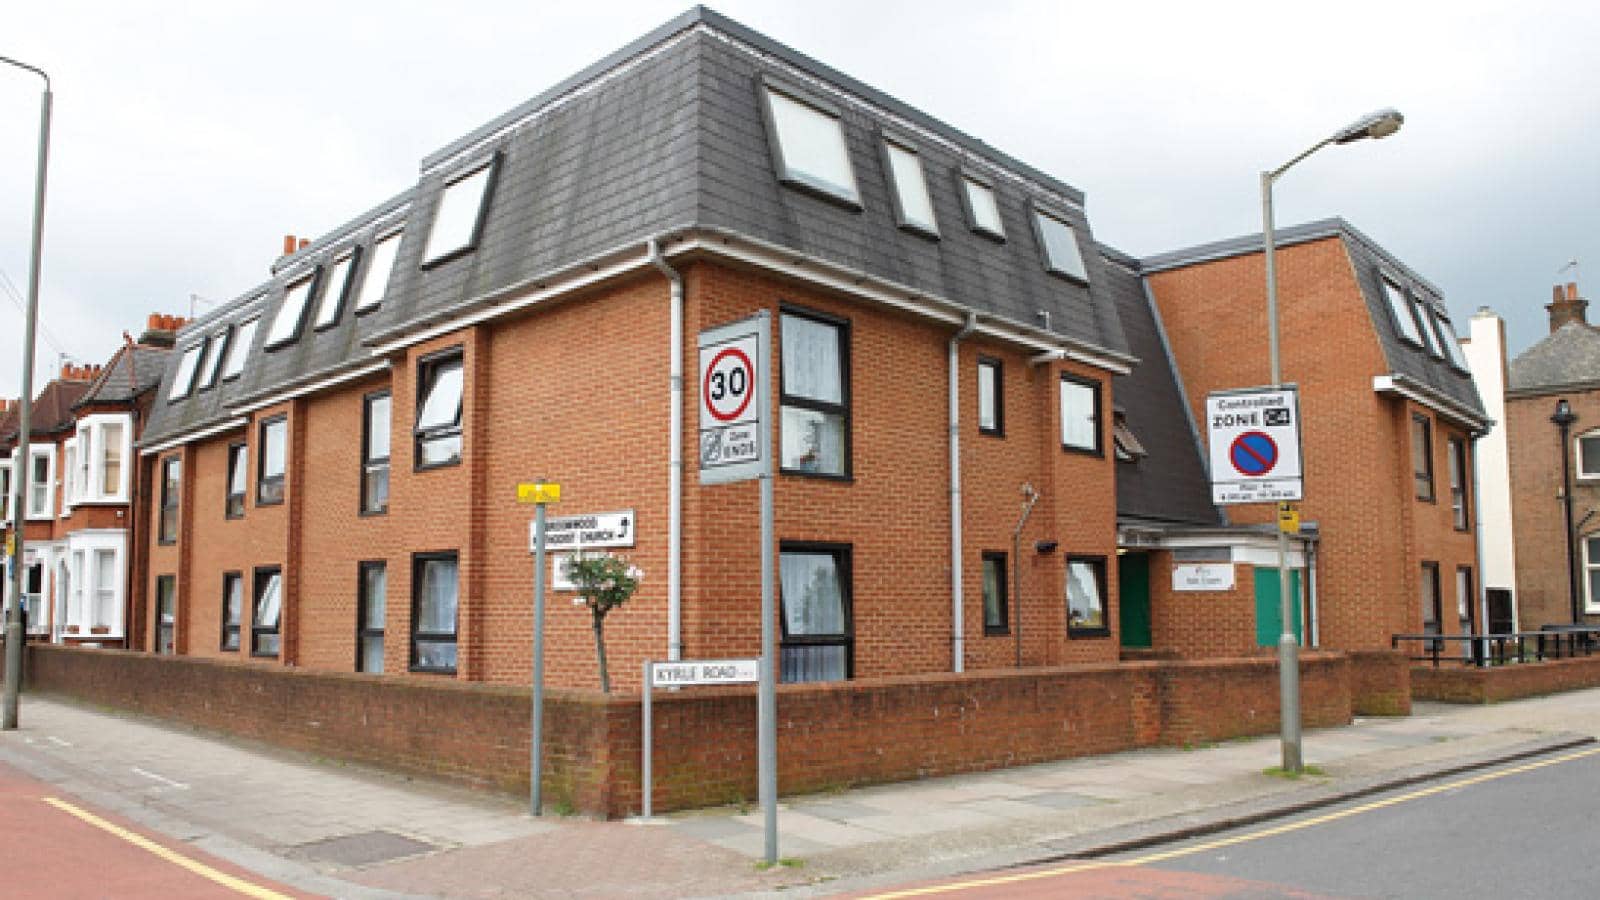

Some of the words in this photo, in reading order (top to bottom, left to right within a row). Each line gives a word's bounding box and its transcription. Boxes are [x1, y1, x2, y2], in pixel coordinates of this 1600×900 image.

[711, 367, 745, 400] 30
[1216, 396, 1284, 411] Controlled
[1212, 411, 1258, 429] ZONE
[723, 441, 754, 459] ENDS
[533, 533, 576, 545] THODIST
[579, 530, 614, 543] CHURCH
[656, 666, 697, 681] KYRLE
[703, 665, 737, 679] ROAD
